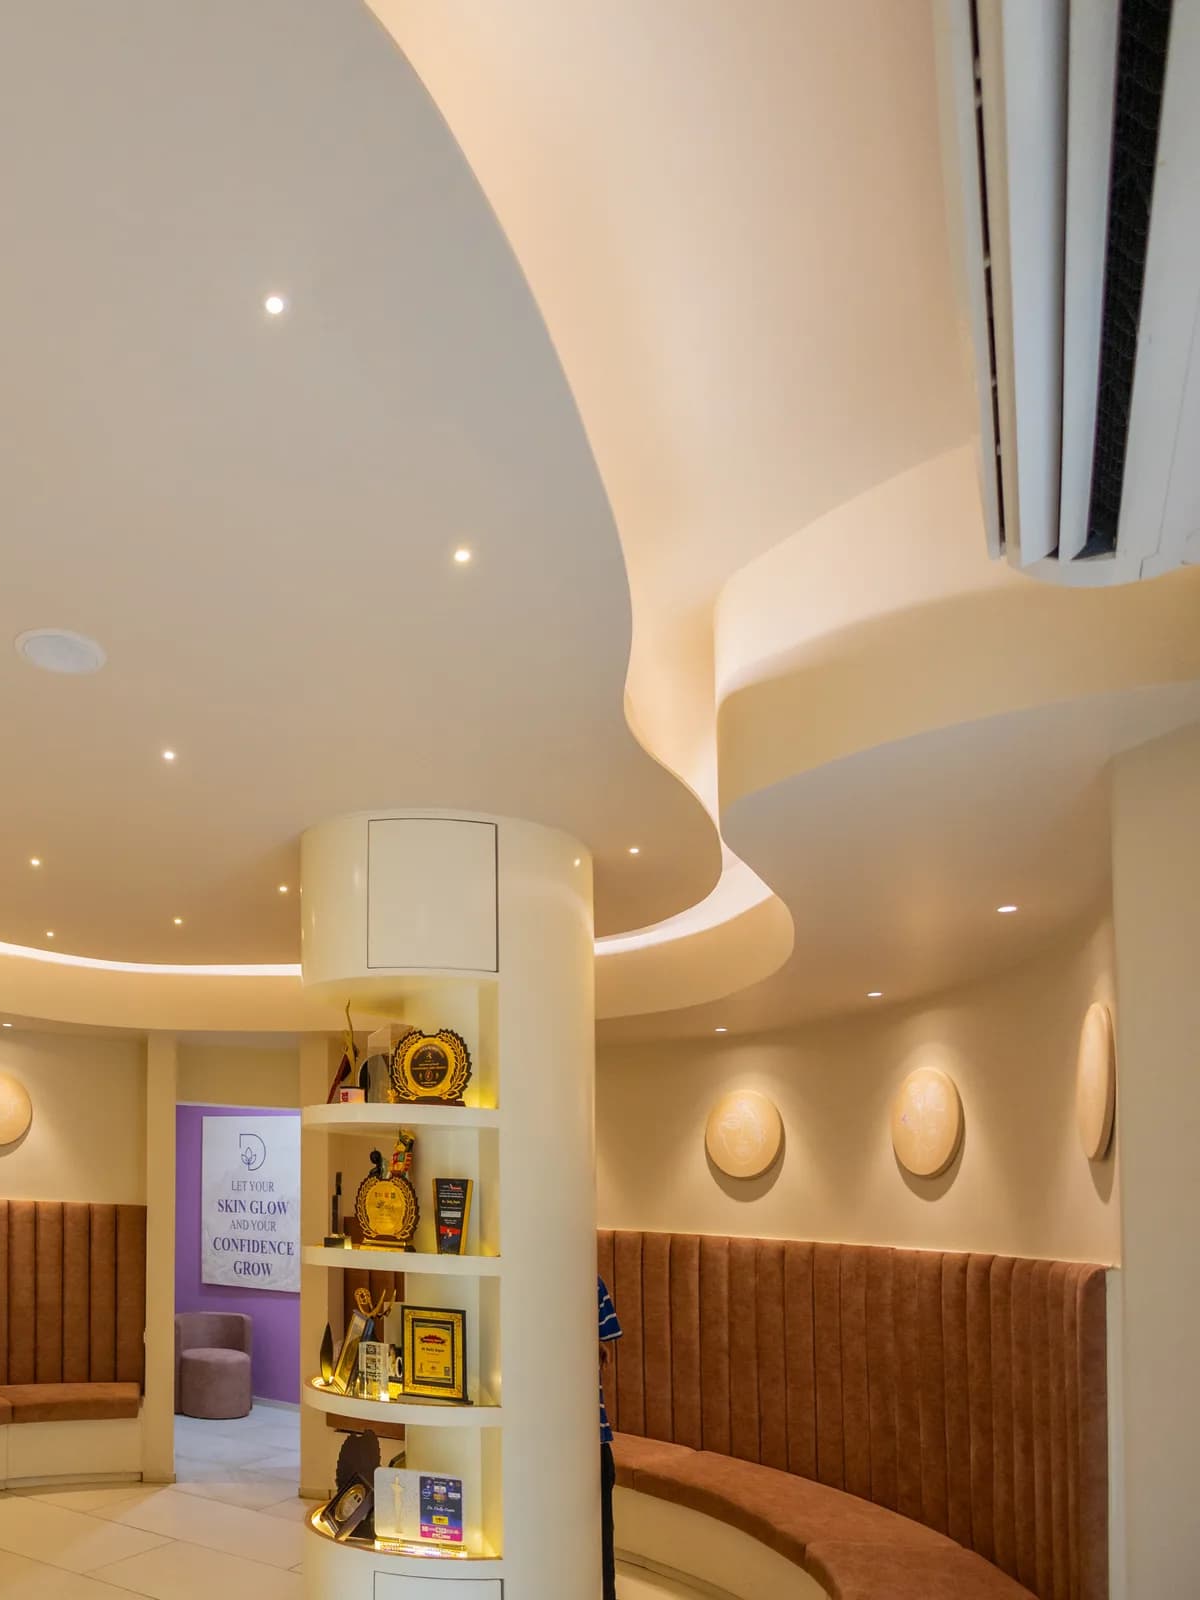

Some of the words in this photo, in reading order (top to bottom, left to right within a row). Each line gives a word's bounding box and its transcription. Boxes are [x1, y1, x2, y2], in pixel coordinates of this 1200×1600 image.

[231, 1180, 247, 1192] LET
[249, 1180, 275, 1193] YOUR
[217, 1199, 247, 1214] SKIN
[249, 1200, 289, 1215] GLOW
[231, 1219, 249, 1231] AND
[251, 1220, 277, 1232] YOUR
[213, 1237, 294, 1256] CONFIDENCE
[233, 1260, 273, 1277] GROW
